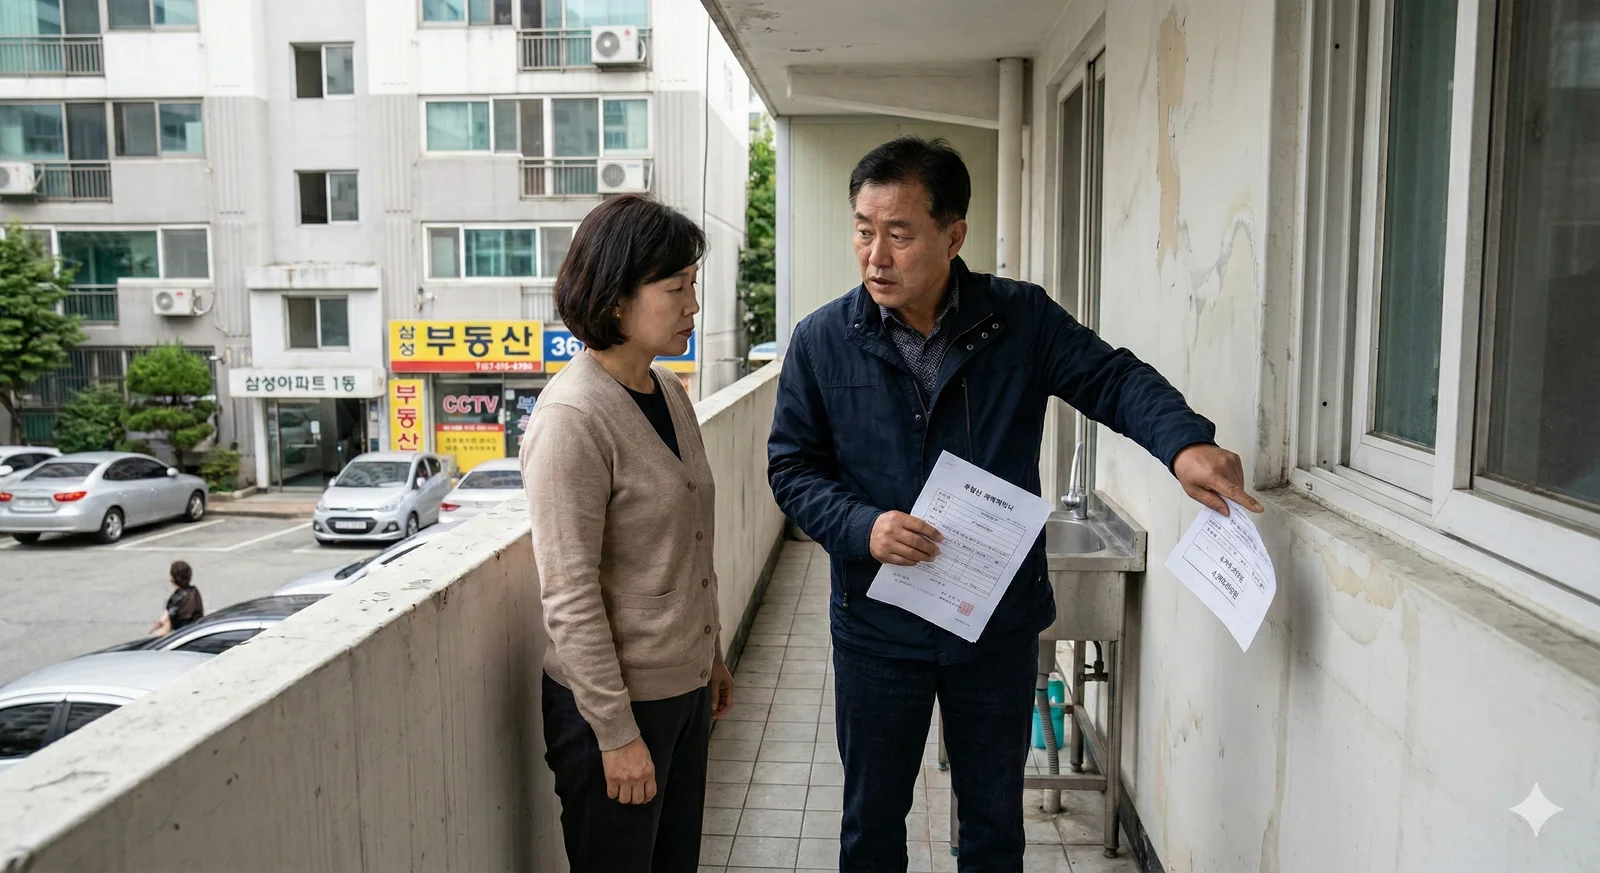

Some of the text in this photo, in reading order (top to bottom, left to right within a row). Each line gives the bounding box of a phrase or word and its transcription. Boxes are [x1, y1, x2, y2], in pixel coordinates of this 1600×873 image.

[399, 326, 533, 357] 삼성 부동산
[246, 376, 356, 392] 삼성아파트 1동
[443, 394, 499, 414] CCTV
[397, 385, 419, 451] 부동산
